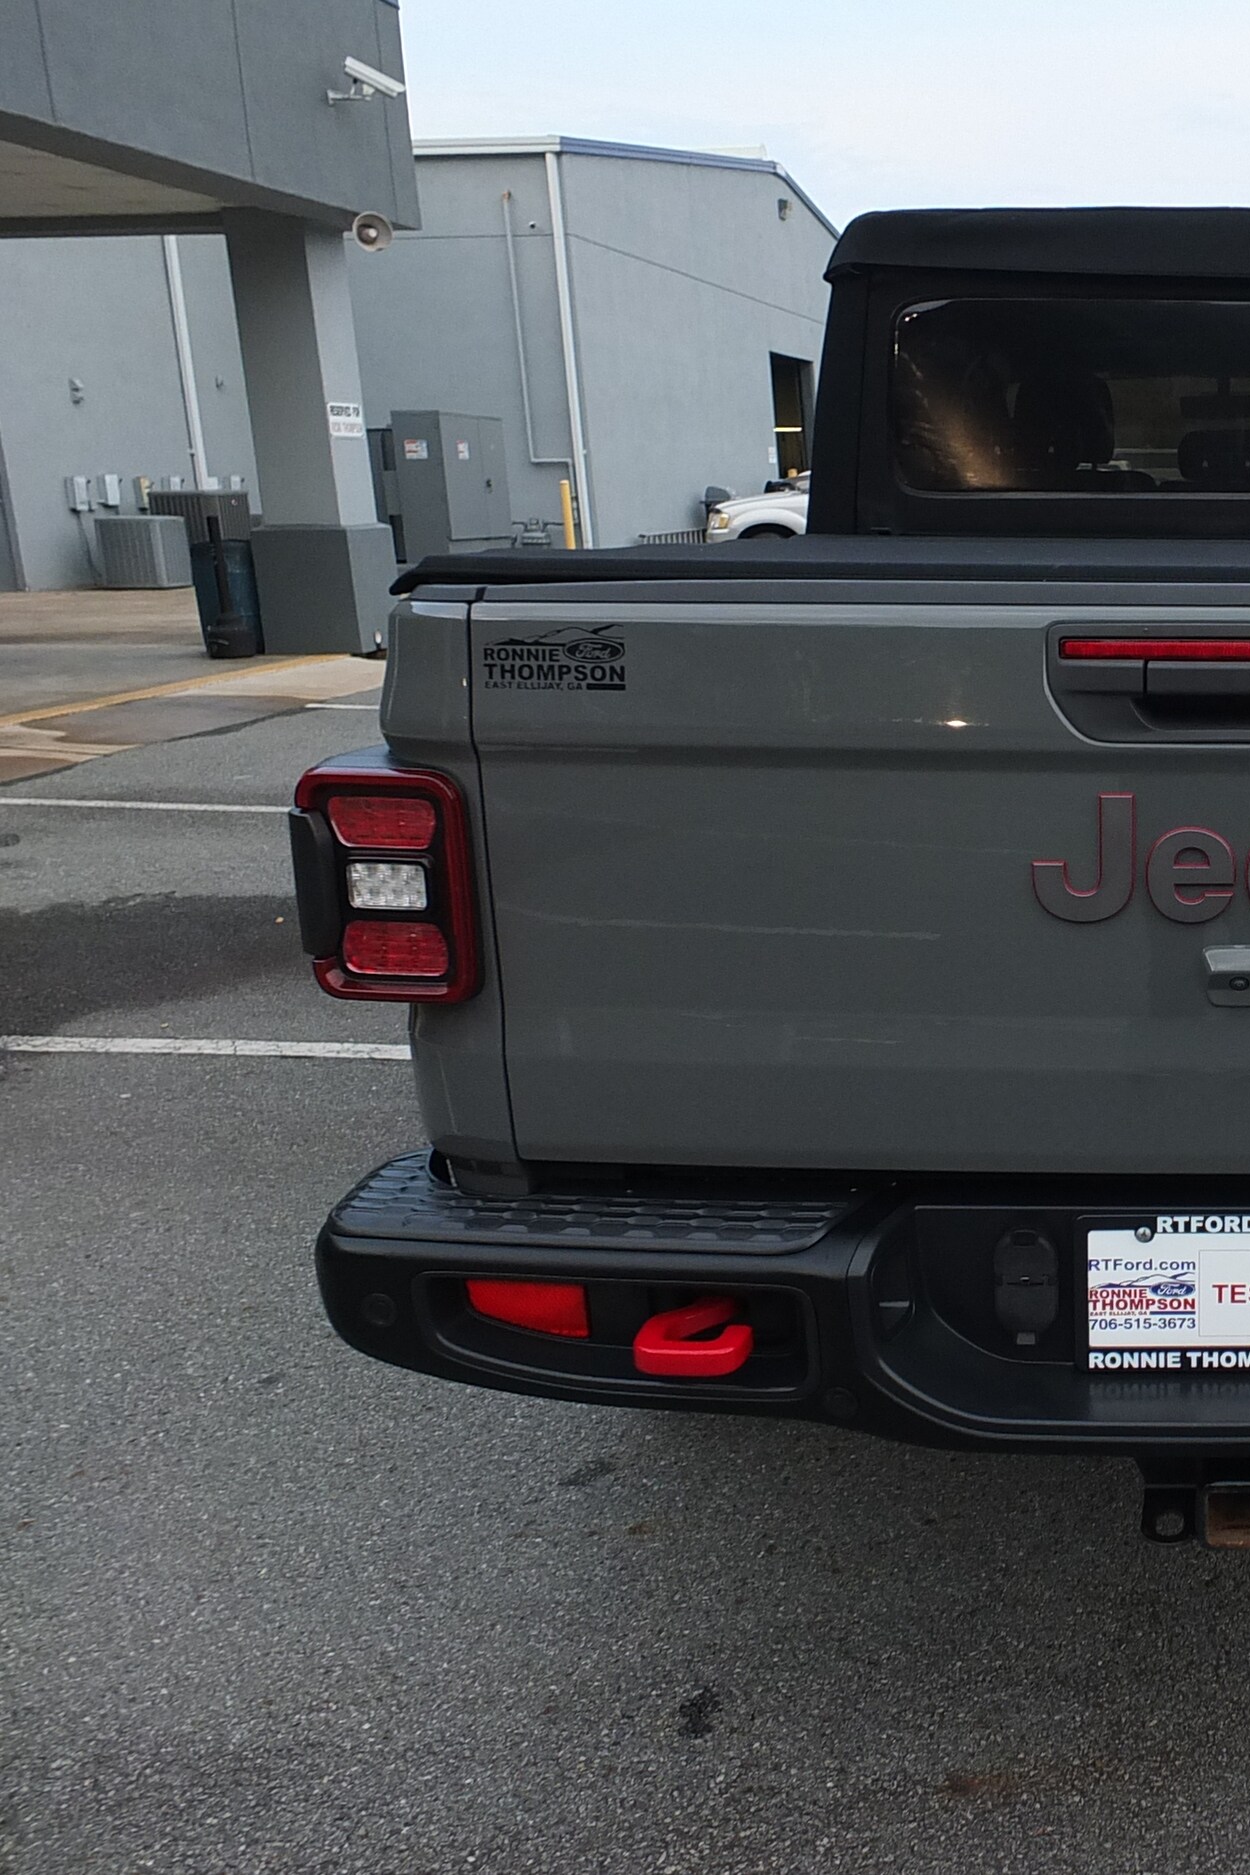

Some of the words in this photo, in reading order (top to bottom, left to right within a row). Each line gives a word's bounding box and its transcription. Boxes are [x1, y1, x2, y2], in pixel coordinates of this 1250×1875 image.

[484, 648, 560, 662] RONNIE
[575, 643, 611, 659] Ford
[484, 664, 625, 682] THOMPSON
[485, 681, 512, 689] EAST
[517, 681, 564, 691] ELLIJAY,
[568, 683, 582, 691] GA
[1088, 1258, 1196, 1271] RTFord.com
[1089, 1289, 1147, 1299] RONNIE
[1156, 1284, 1186, 1296] Ford
[1089, 1298, 1195, 1310] THOMPSON
[1090, 1318, 1195, 1330] 706-515-3673
[1089, 1352, 1181, 1368] RONNIE
